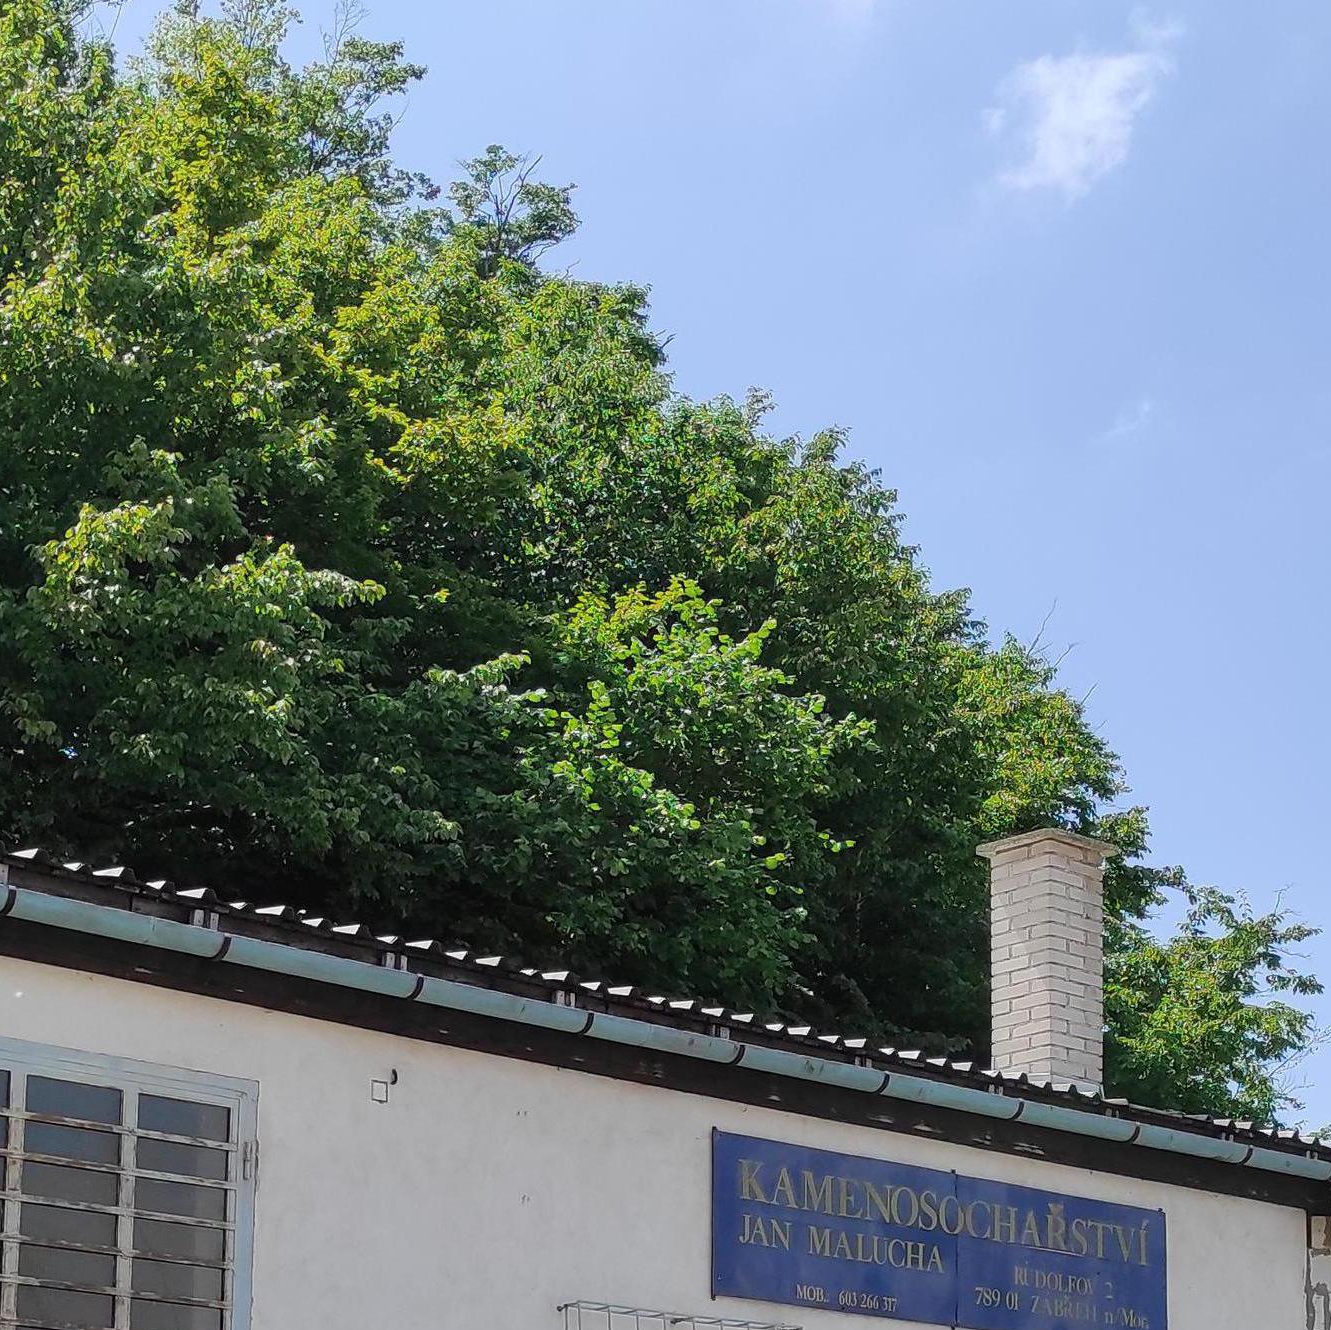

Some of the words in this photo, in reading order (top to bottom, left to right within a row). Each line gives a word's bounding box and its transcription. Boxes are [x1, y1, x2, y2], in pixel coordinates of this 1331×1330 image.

[737, 1158, 1149, 1266] KAMENOSOCHAŘSTVÍ
[739, 1214, 792, 1251] JAN
[808, 1225, 945, 1274] MALUCHA
[838, 1290, 857, 1307] 603
[882, 1296, 898, 1312] 317
[974, 1287, 1001, 1308] 789
[1005, 1291, 1019, 1311] 01
